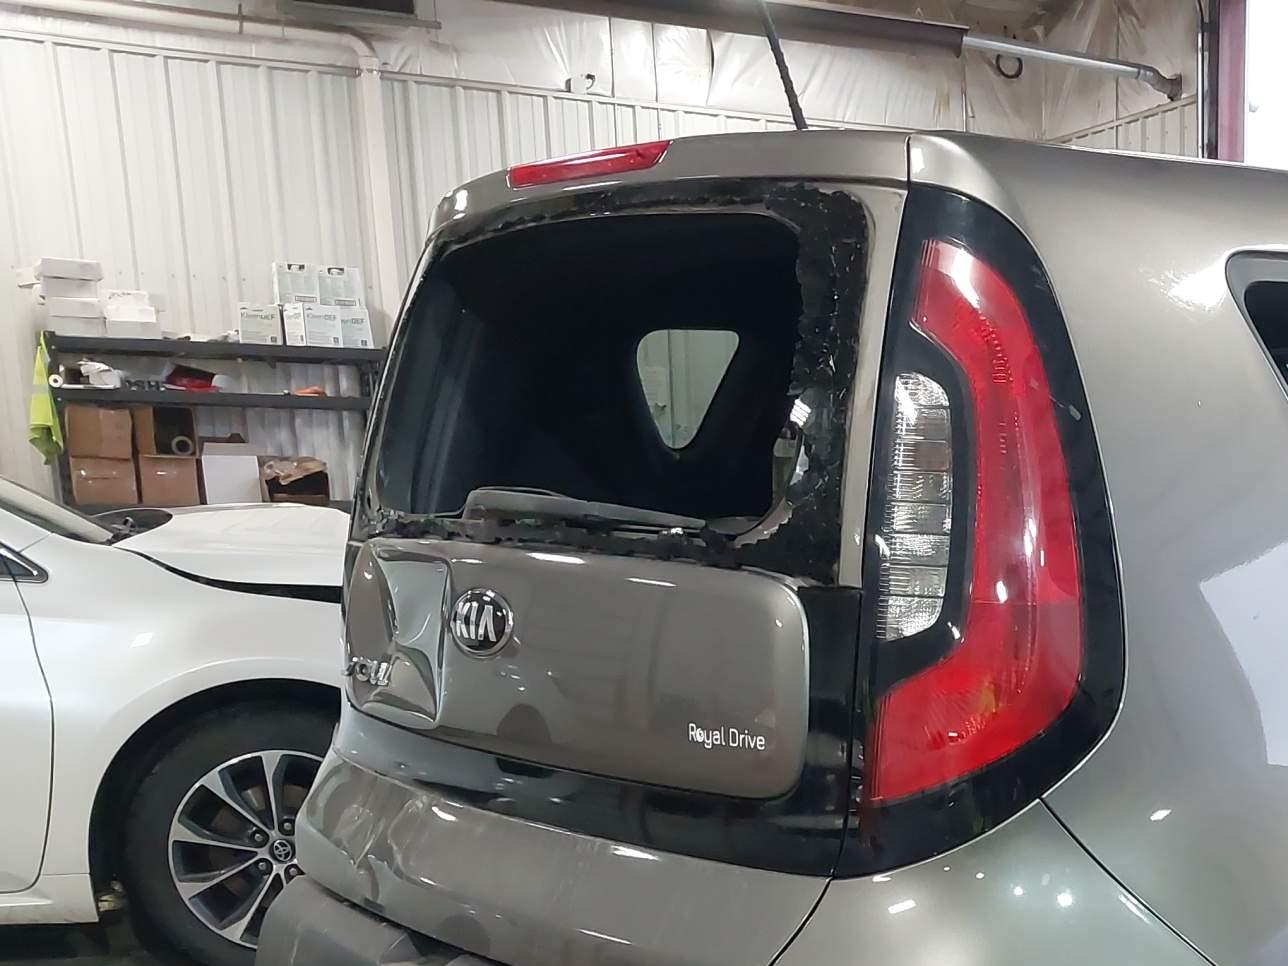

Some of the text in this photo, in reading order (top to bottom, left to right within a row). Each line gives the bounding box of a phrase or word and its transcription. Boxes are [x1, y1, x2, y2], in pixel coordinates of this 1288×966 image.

[456, 601, 497, 642] KIA
[688, 722, 766, 751] Royal Drive
